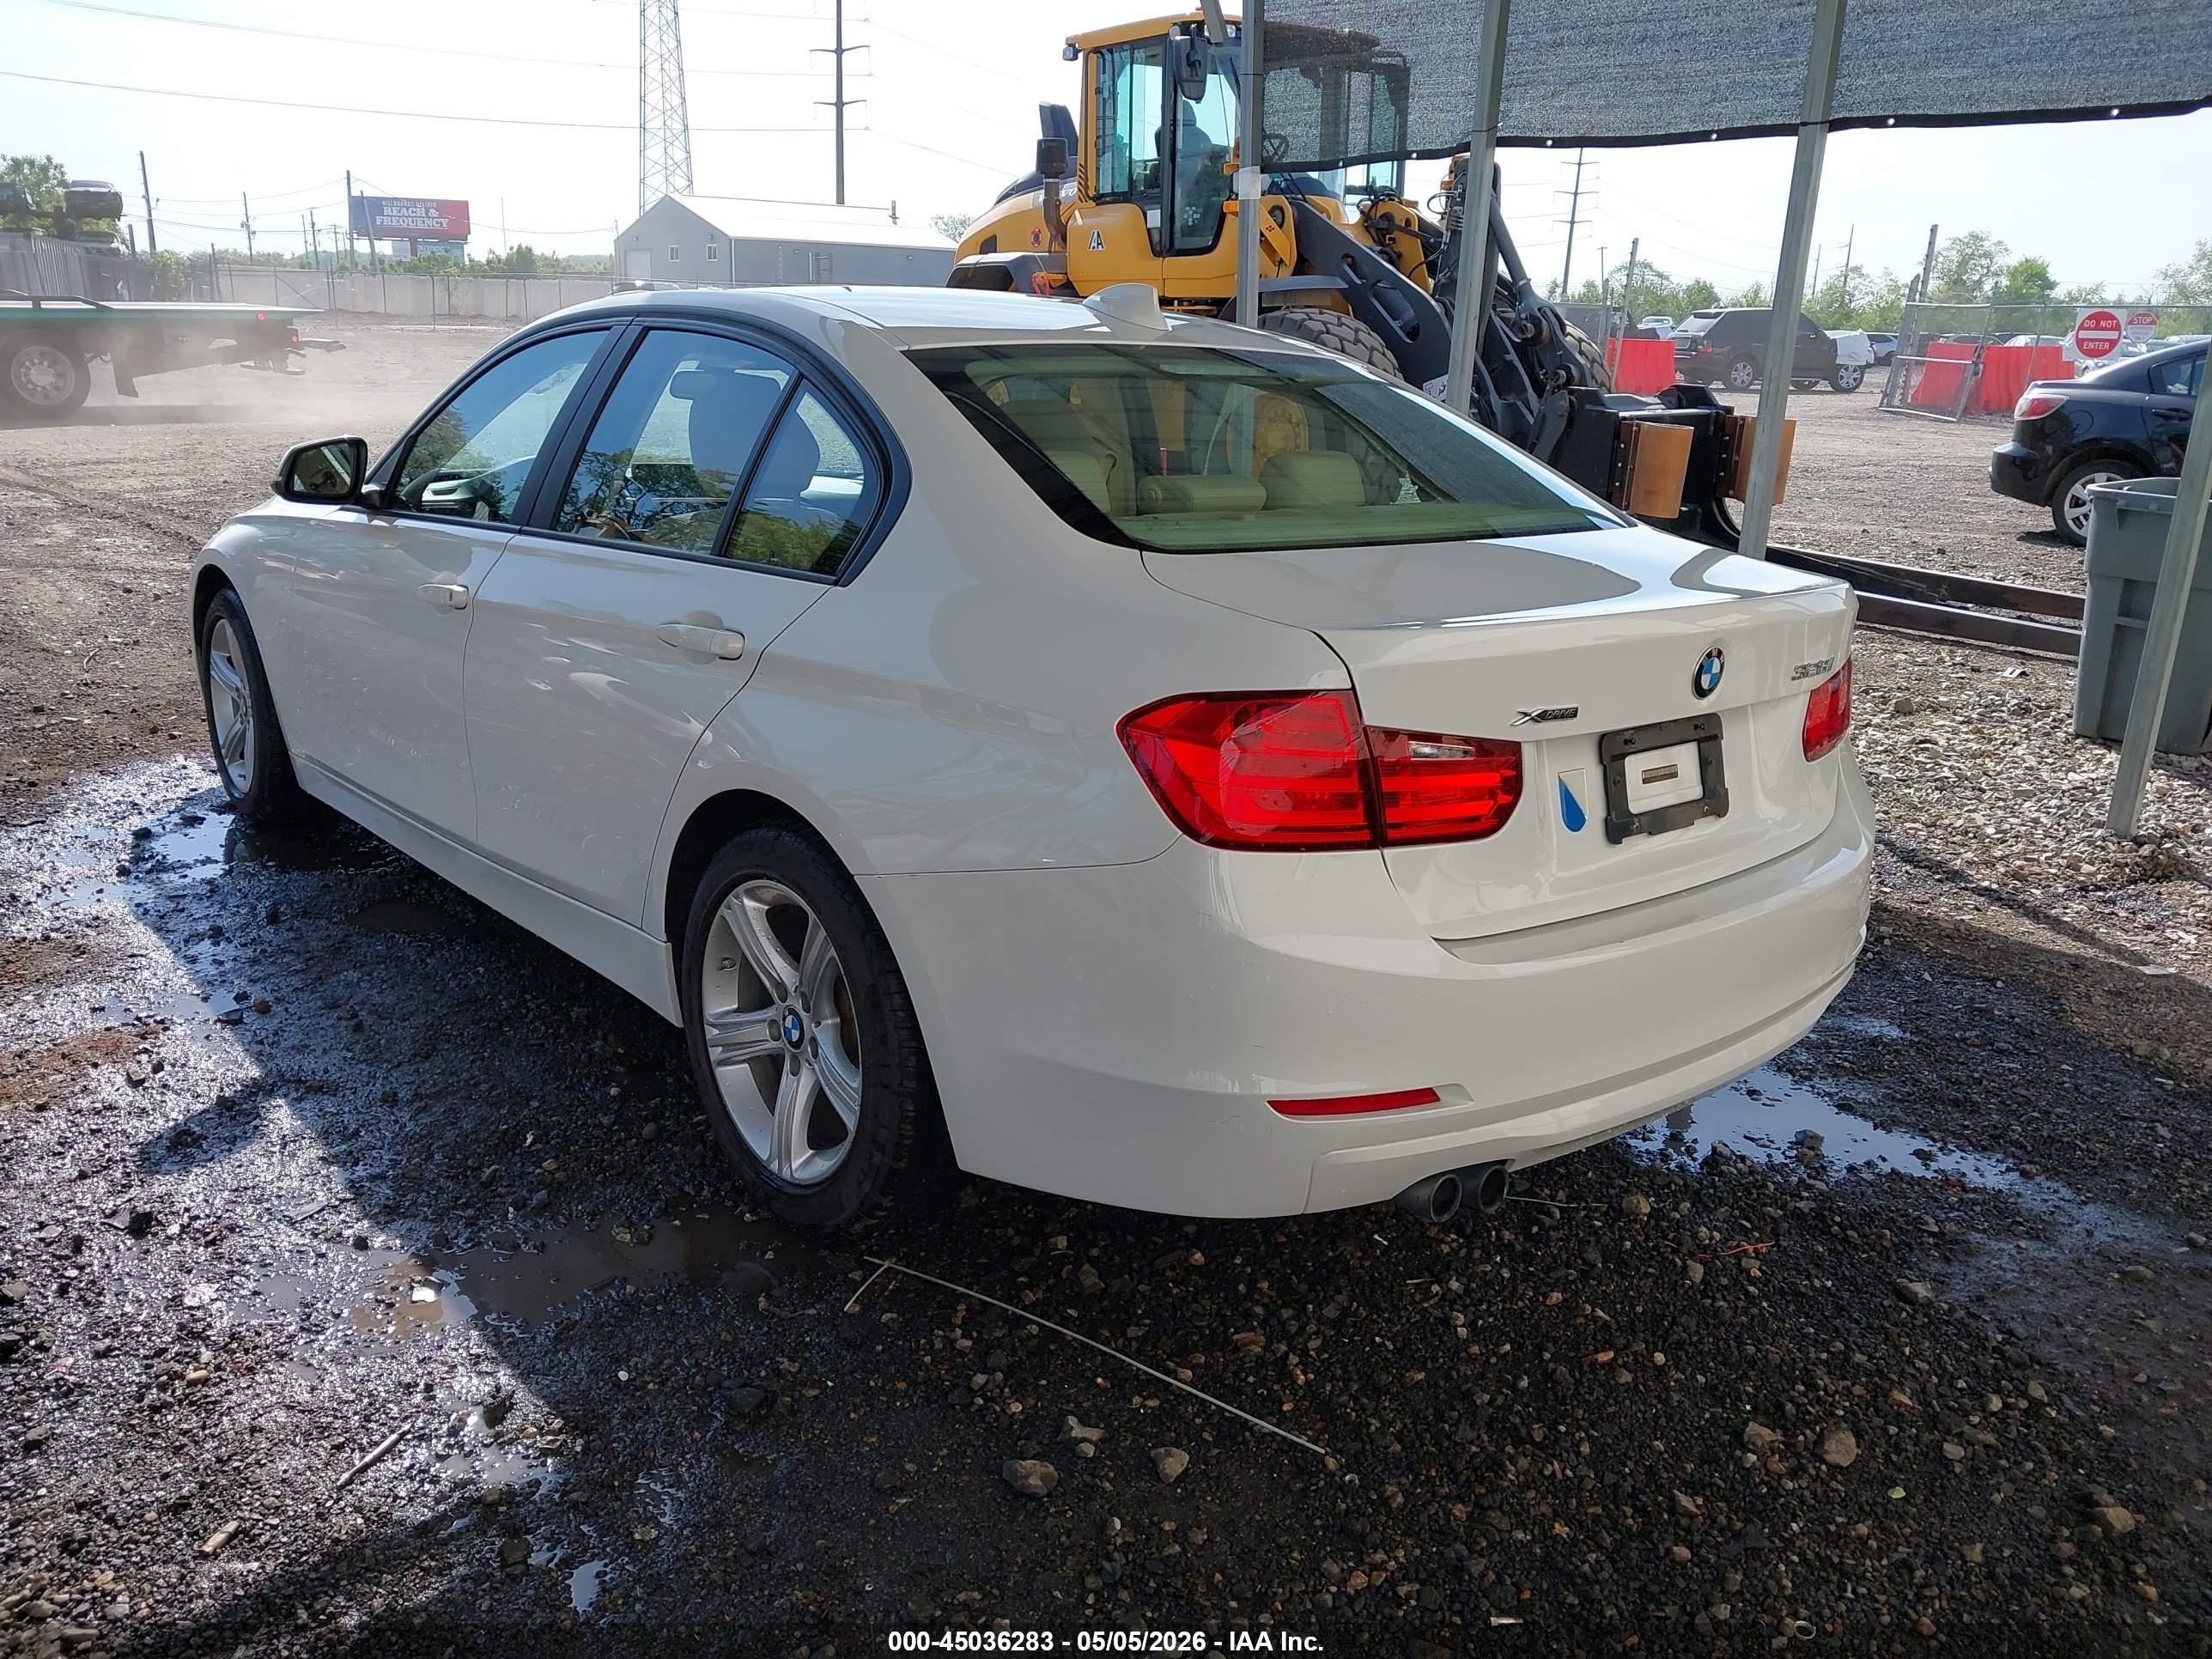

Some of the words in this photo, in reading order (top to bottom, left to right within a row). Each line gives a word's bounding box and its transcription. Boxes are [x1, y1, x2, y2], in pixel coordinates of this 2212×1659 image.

[383, 206, 425, 217] REACH
[428, 208, 440, 217] &
[375, 216, 449, 228] FREQUENCY
[2084, 319, 2096, 328] DO
[2100, 319, 2118, 328] NOT
[2133, 316, 2153, 325] STOP
[2083, 341, 2110, 349] ENTER
